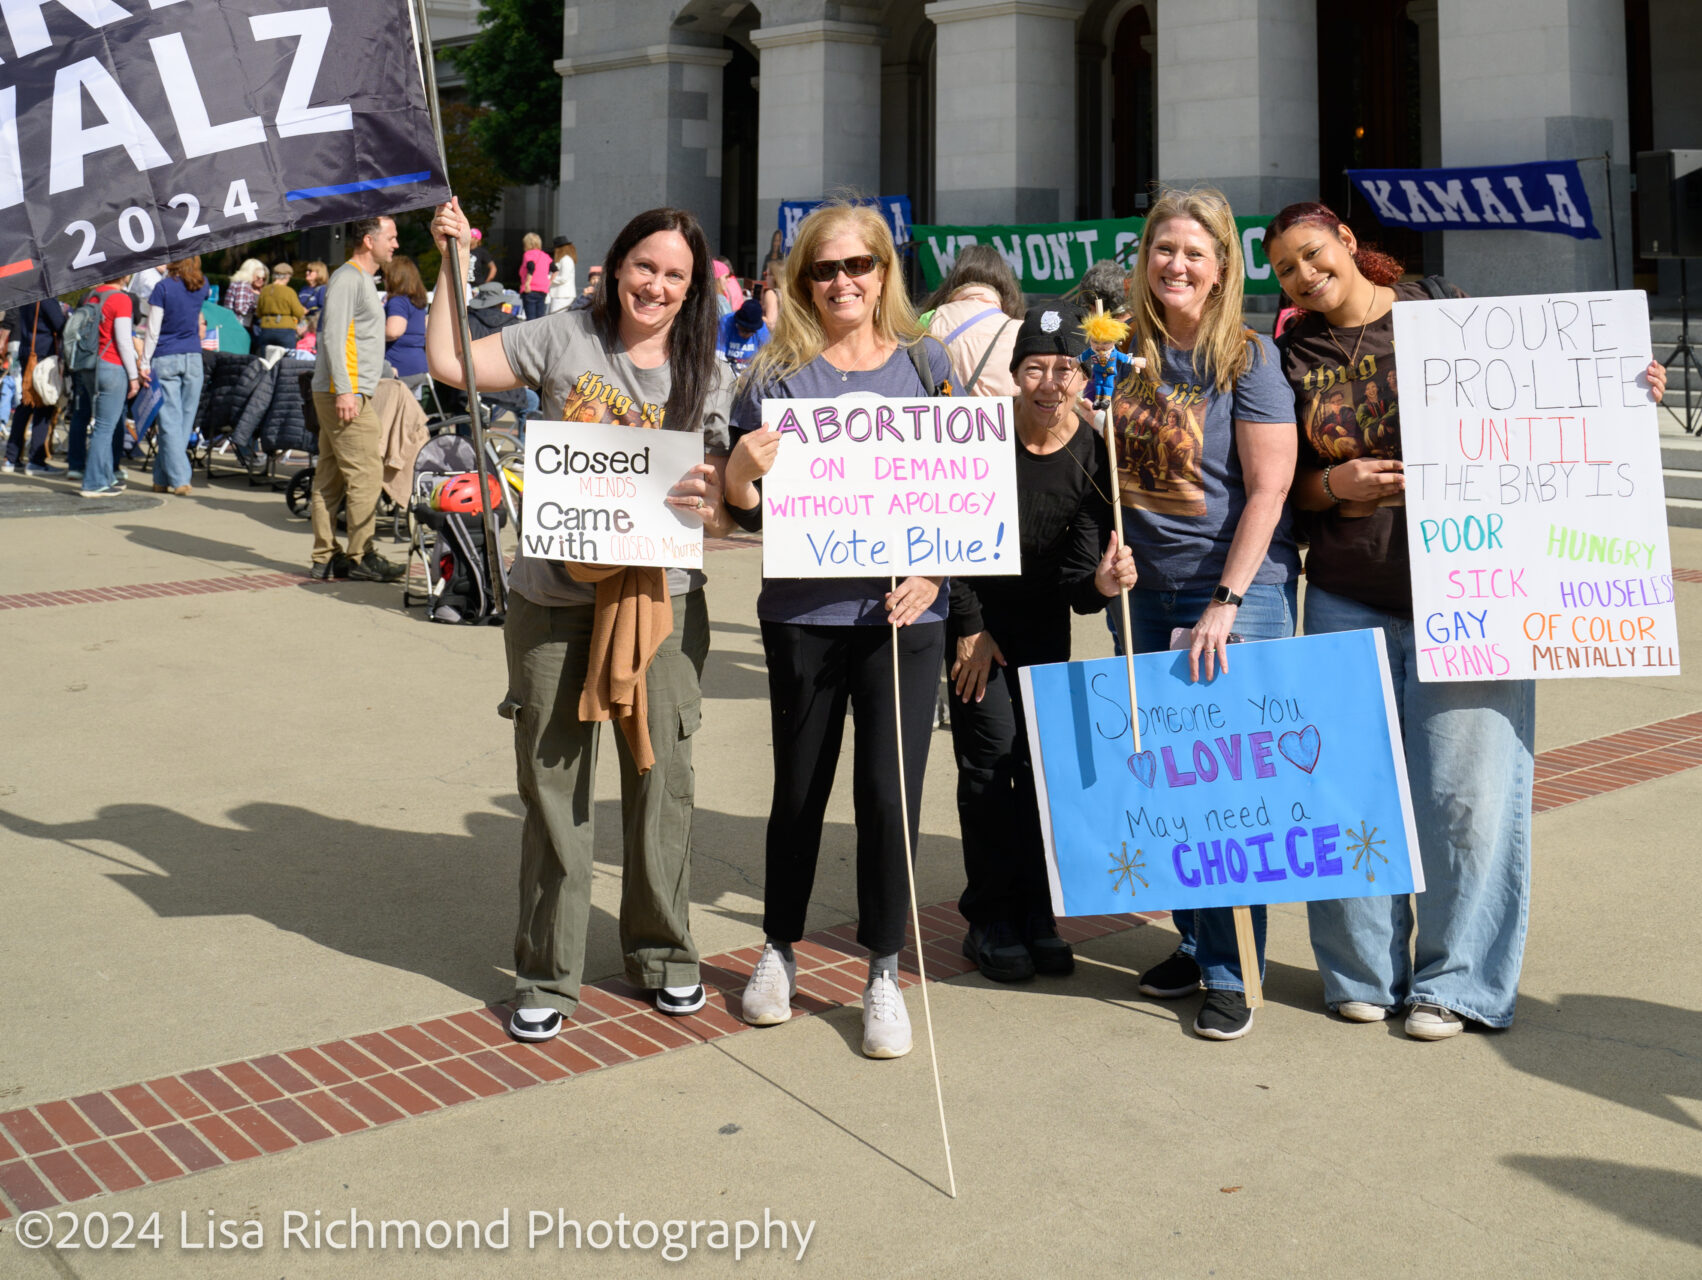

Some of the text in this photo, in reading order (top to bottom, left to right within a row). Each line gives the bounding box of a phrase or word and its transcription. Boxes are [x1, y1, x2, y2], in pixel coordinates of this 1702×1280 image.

[0, 7, 353, 209] ALZ
[1362, 173, 1586, 229] KAMALA
[64, 179, 258, 269] 2024
[992, 229, 1098, 281] WON'T
[1439, 299, 1617, 352] YOU'RE
[575, 370, 633, 416] thug
[1424, 356, 1647, 410] PRO-LIFE
[776, 403, 1006, 443] ABORTION
[1459, 417, 1612, 463] UNTIL
[535, 444, 650, 475] Closed
[810, 456, 989, 481] ON DEMAND
[579, 477, 636, 497] MINDS
[768, 491, 995, 517] WITHOUT APOLOGY
[1408, 463, 1634, 504] THE BABY IS
[537, 501, 634, 534] Came
[1420, 513, 1503, 553] POOR
[525, 532, 598, 561] with
[807, 522, 1005, 566] Vote Blue!
[1547, 524, 1656, 570] HUNGRY
[1445, 568, 1528, 599] SICK
[1426, 610, 1487, 644] GAY
[1523, 612, 1656, 643] OF COLOR
[1421, 643, 1510, 677] TRANS
[1533, 645, 1679, 671] MENTALLY ILL
[1161, 731, 1277, 787] LOVE
[1127, 796, 1311, 843] May need a
[1172, 823, 1343, 888] CHOICE
